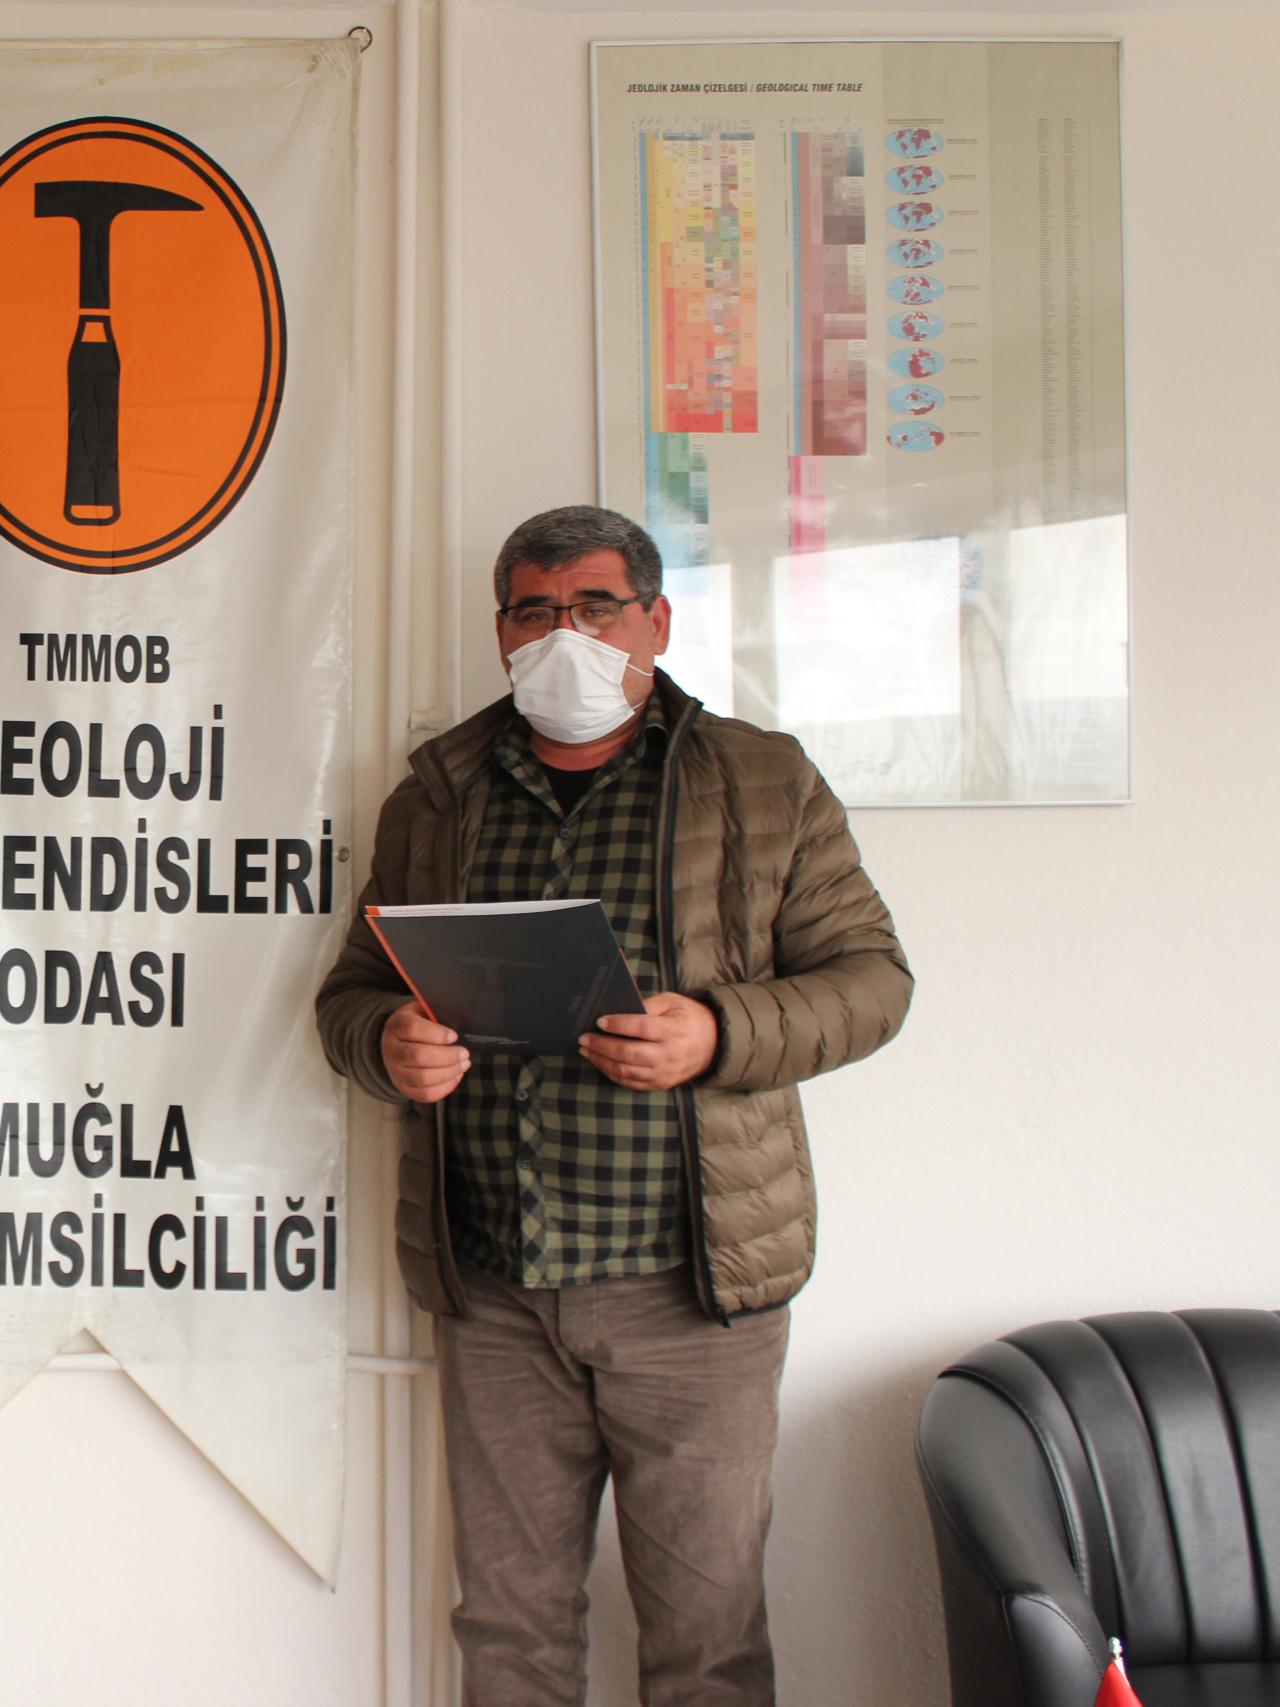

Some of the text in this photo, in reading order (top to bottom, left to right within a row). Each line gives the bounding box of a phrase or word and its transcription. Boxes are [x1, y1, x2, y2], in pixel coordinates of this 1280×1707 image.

[626, 82, 668, 93] JEOLOJİK
[670, 83, 701, 93] ZAMAN
[703, 82, 748, 95] ÇİZELGESİ
[755, 83, 809, 92] GEOLOGICAL
[812, 83, 834, 92] TIME
[836, 83, 864, 92] TABLE
[19, 632, 170, 684] TMMOB
